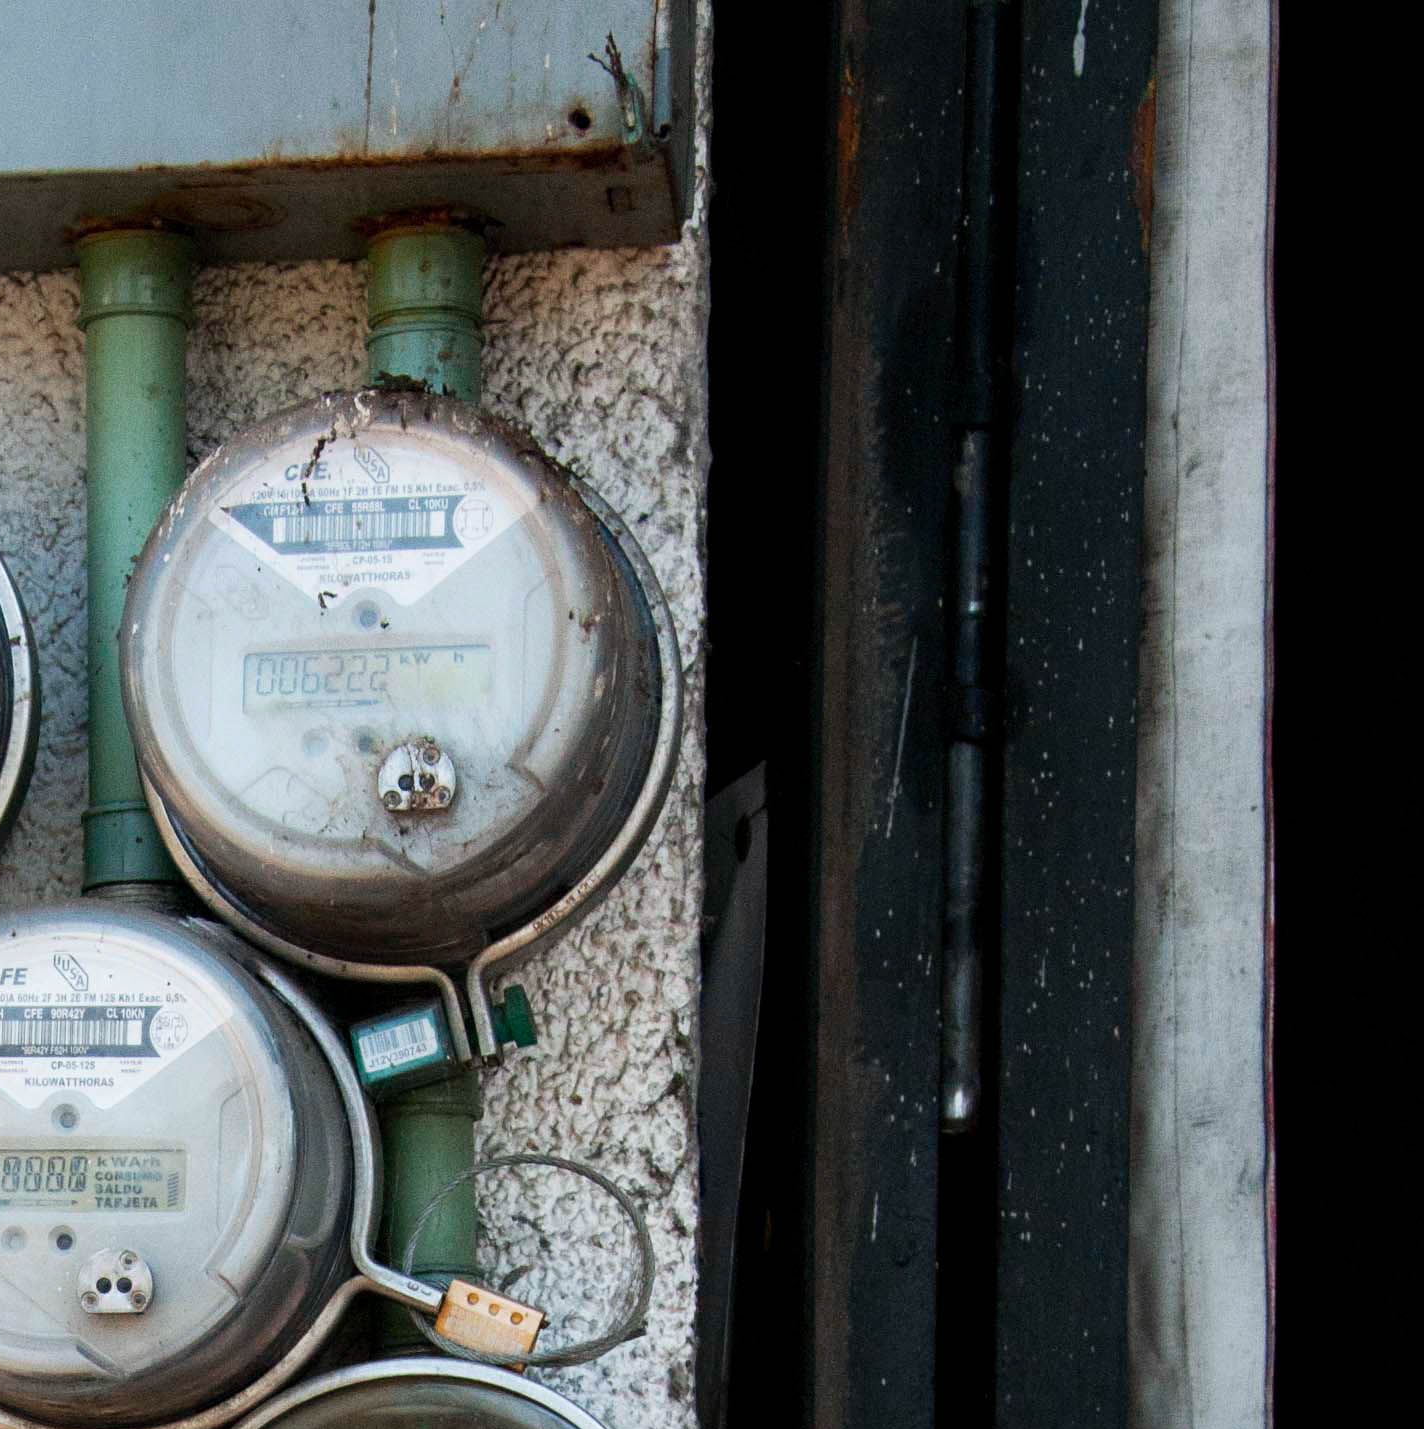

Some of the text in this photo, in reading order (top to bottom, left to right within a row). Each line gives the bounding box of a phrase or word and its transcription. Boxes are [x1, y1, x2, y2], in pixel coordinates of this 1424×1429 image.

[325, 503, 344, 514] CFE
[408, 499, 421, 510] CL
[319, 571, 410, 583] KILOWATTHORAS
[256, 654, 390, 694] 006222
[56, 955, 85, 988] IUSA
[24, 1008, 43, 1019] CFE
[106, 1008, 118, 1018] CL
[25, 1077, 115, 1087] KILOWATTHORAS
[95, 1171, 162, 1182] CONSUMO
[94, 1197, 158, 1208] TARJETA
